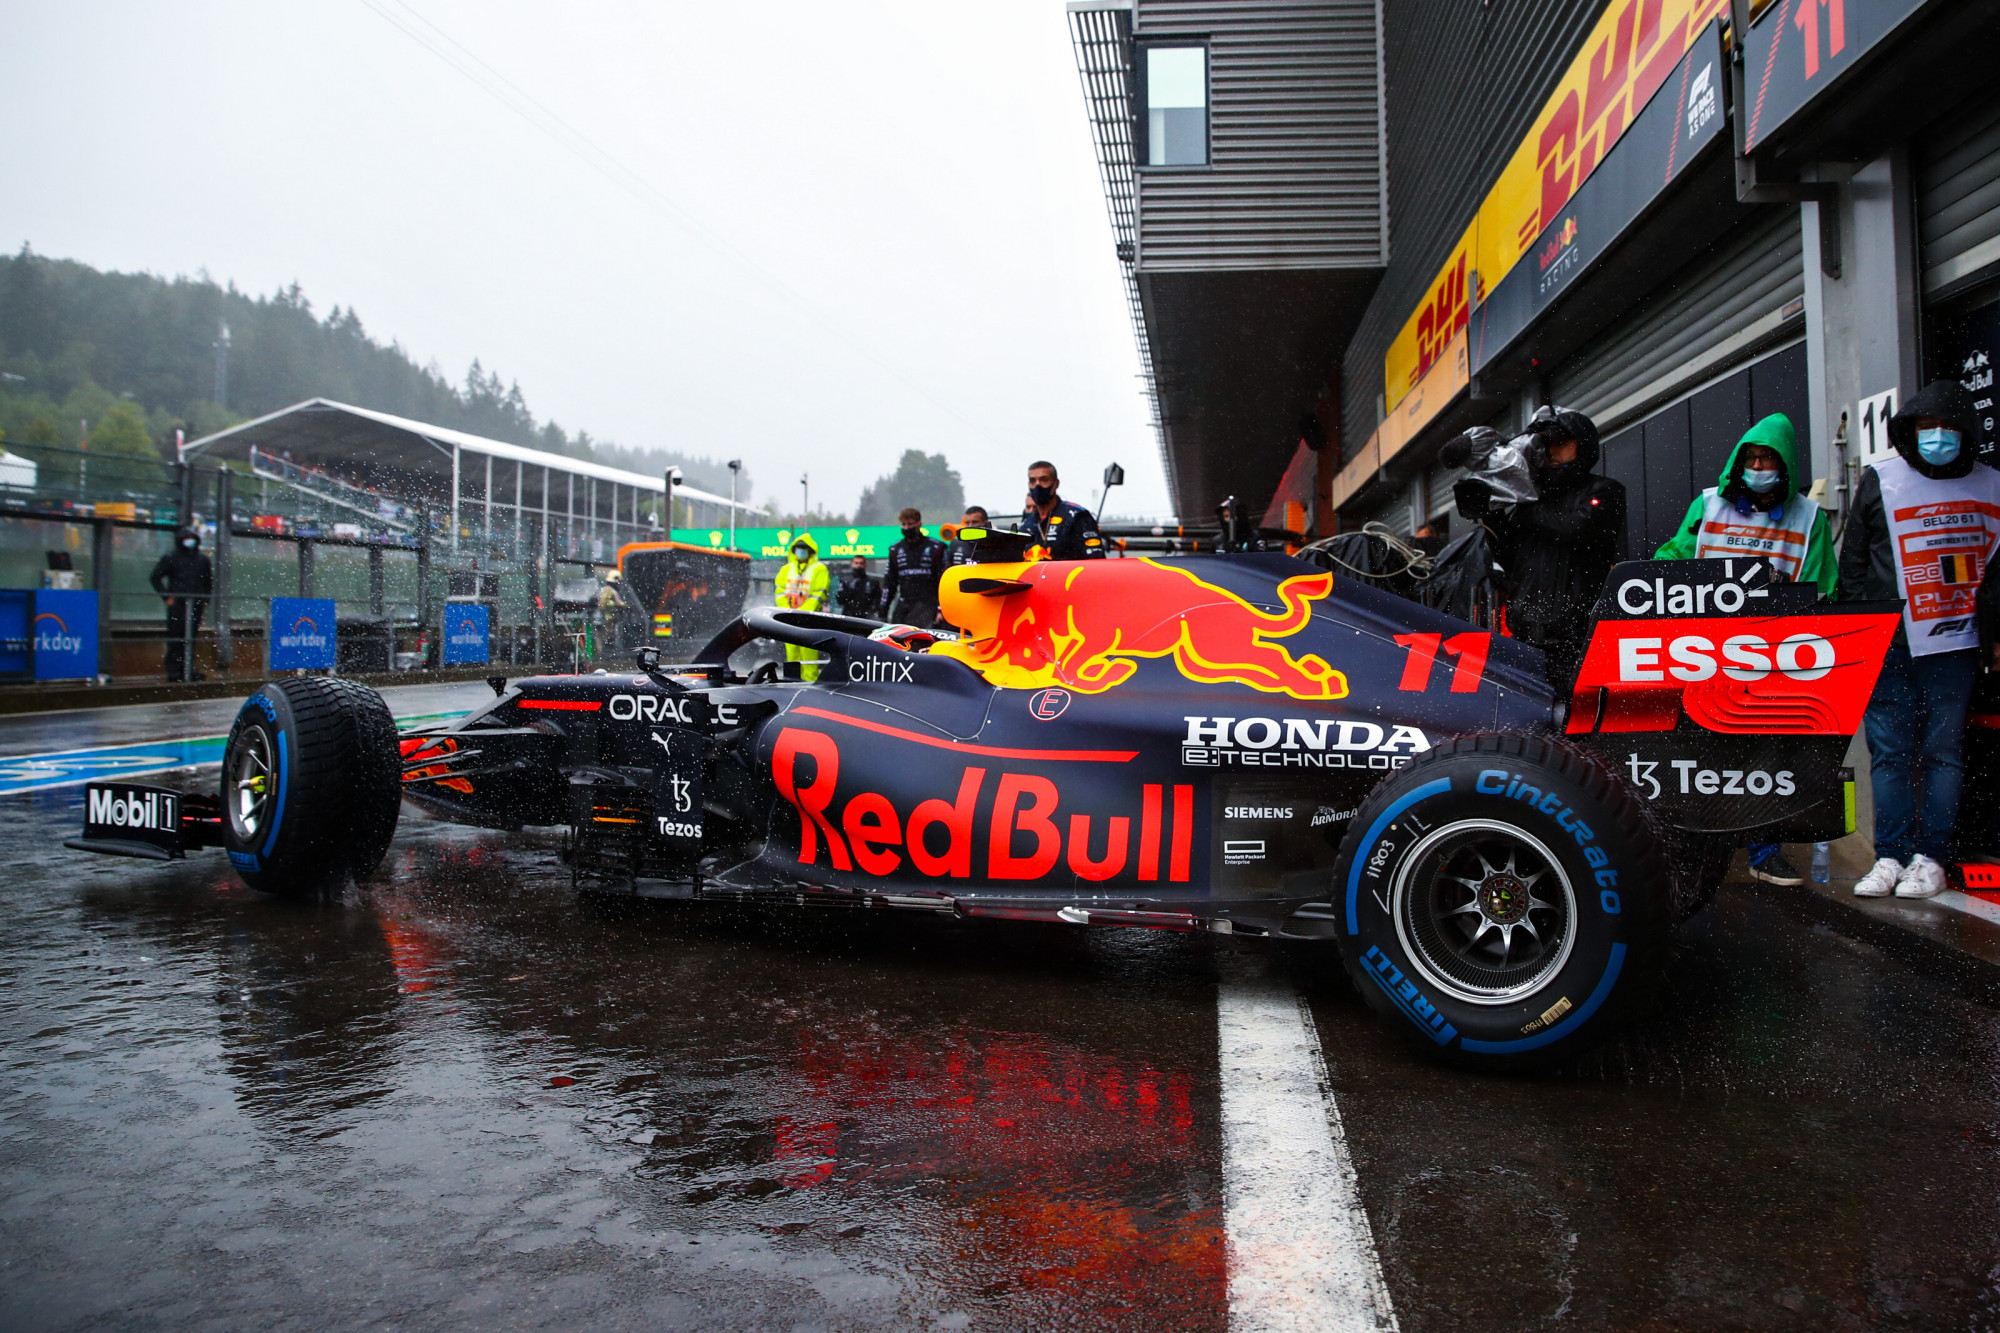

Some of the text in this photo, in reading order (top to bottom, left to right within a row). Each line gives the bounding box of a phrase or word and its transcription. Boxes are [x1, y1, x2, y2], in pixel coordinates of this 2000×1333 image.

[1688, 100, 1716, 140] AS ONE
[1863, 394, 1893, 455] 11
[1923, 514, 1974, 527] BEL20 61
[762, 546, 790, 556] ROL
[831, 545, 875, 556] ROLEX
[1727, 536, 1774, 550] BEL20 12
[1617, 577, 1746, 615] Claro
[849, 656, 915, 683] citrix
[1393, 632, 1492, 693] 11
[1618, 633, 1836, 682] ESSO
[1182, 716, 1432, 753] HONDA
[1671, 760, 1796, 796] Tezos
[89, 788, 157, 829] Mobil
[658, 816, 703, 838] Tezos
[1224, 806, 1294, 819] SIEMENS
[1476, 769, 1621, 914] Cinturato
[1359, 945, 1458, 1047] PIRELLI
